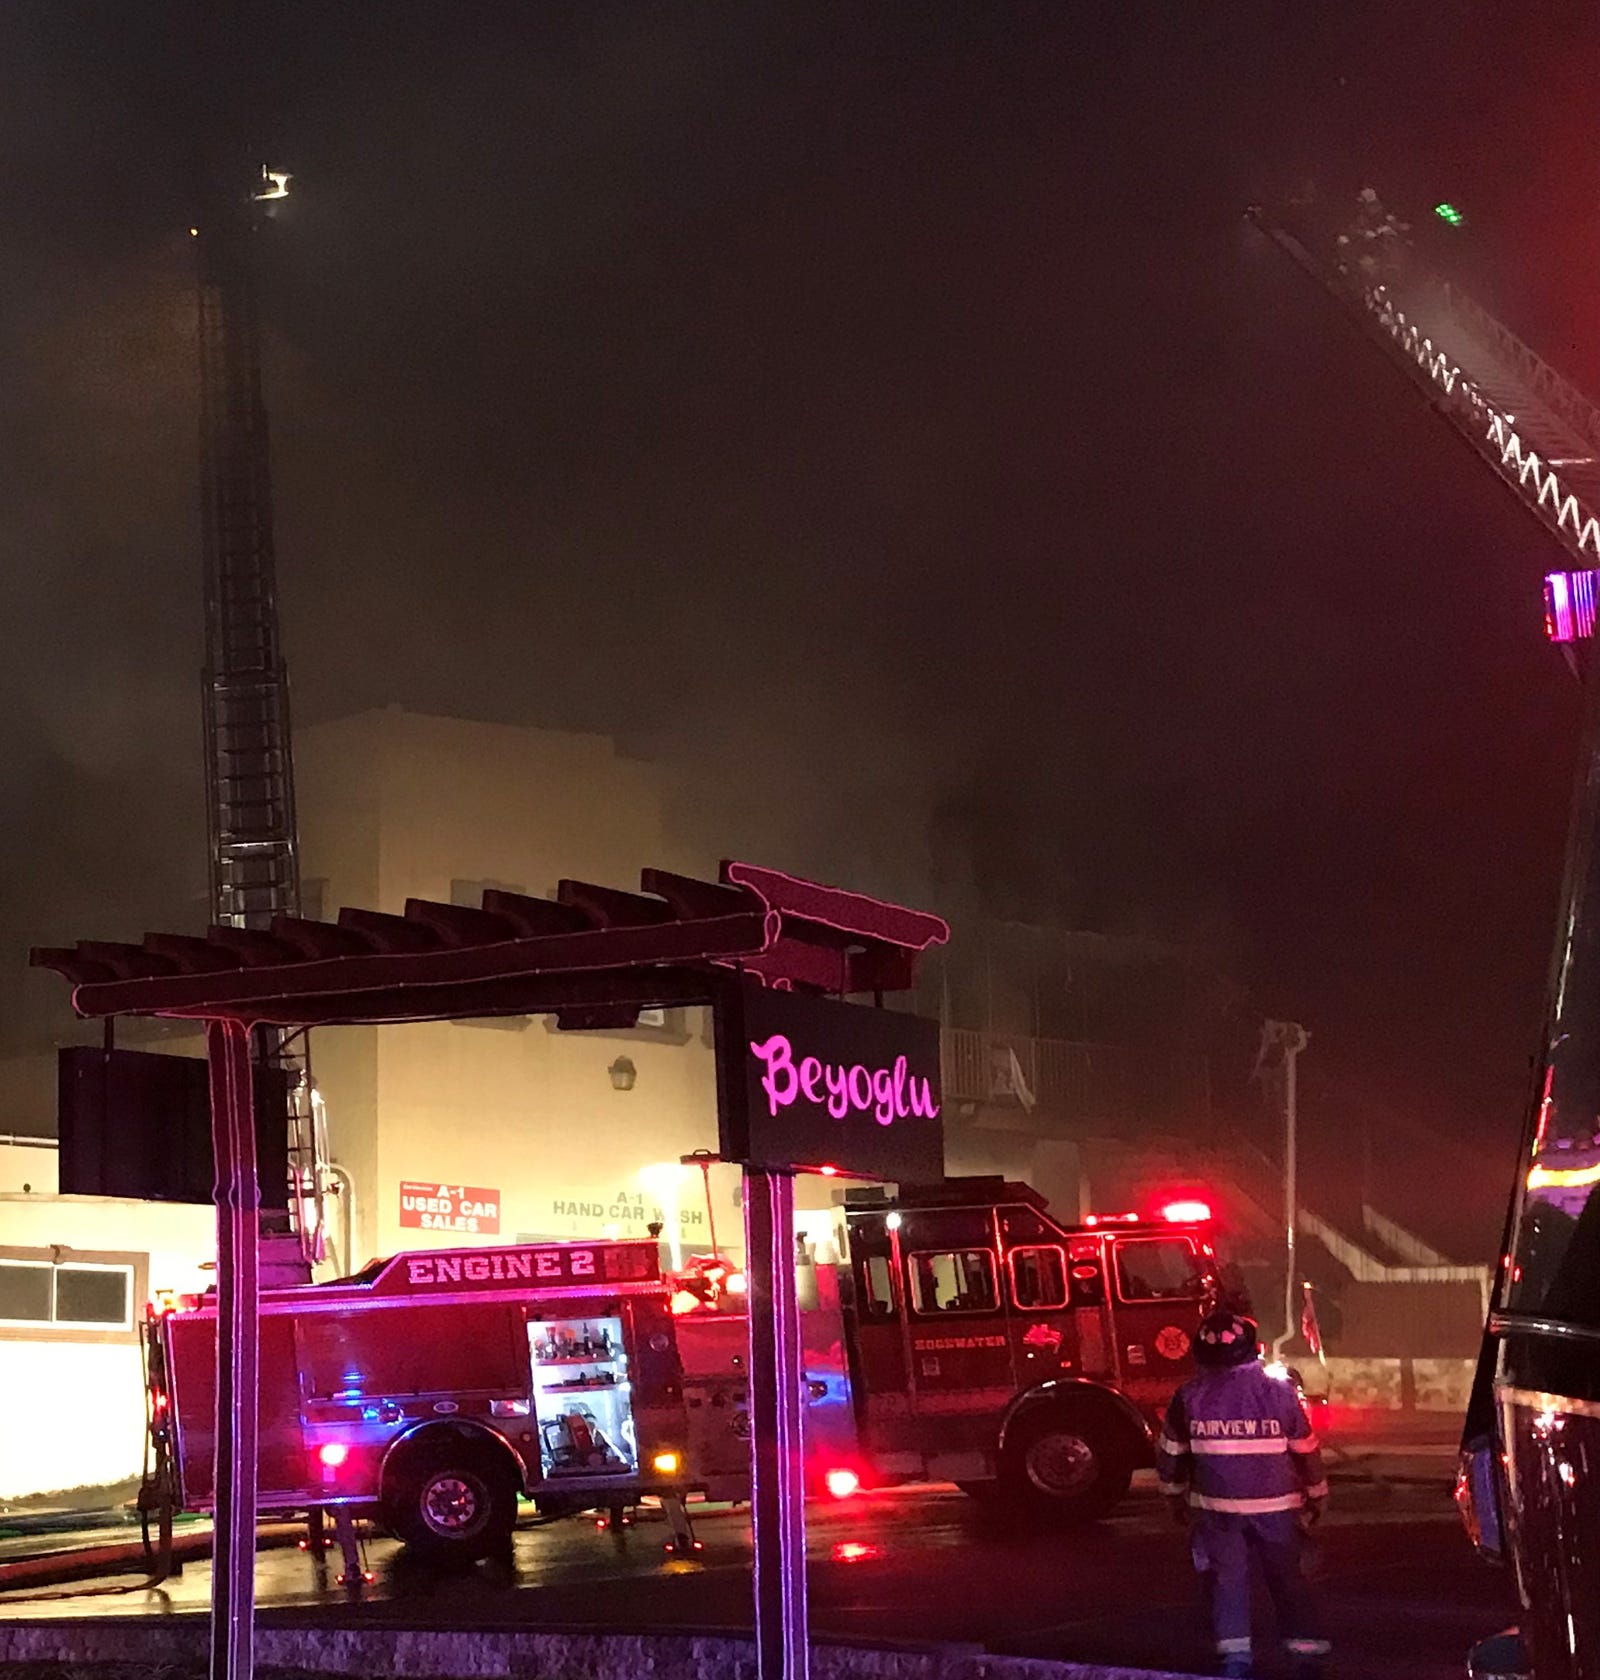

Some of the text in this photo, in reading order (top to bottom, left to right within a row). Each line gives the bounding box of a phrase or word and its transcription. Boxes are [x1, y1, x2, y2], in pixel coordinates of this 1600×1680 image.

[750, 1035, 940, 1126] Beyoglu
[437, 1185, 465, 1199] A-1
[617, 1192, 642, 1204] A-1
[402, 1195, 497, 1218] USED CAR
[553, 1201, 702, 1224] HAND CAR WSH
[420, 1213, 479, 1232] SALES
[407, 1251, 595, 1283] ENGINE 2
[915, 1336, 1006, 1350] EDGEWATER
[1190, 1420, 1281, 1435] FAIRVIEW FD
